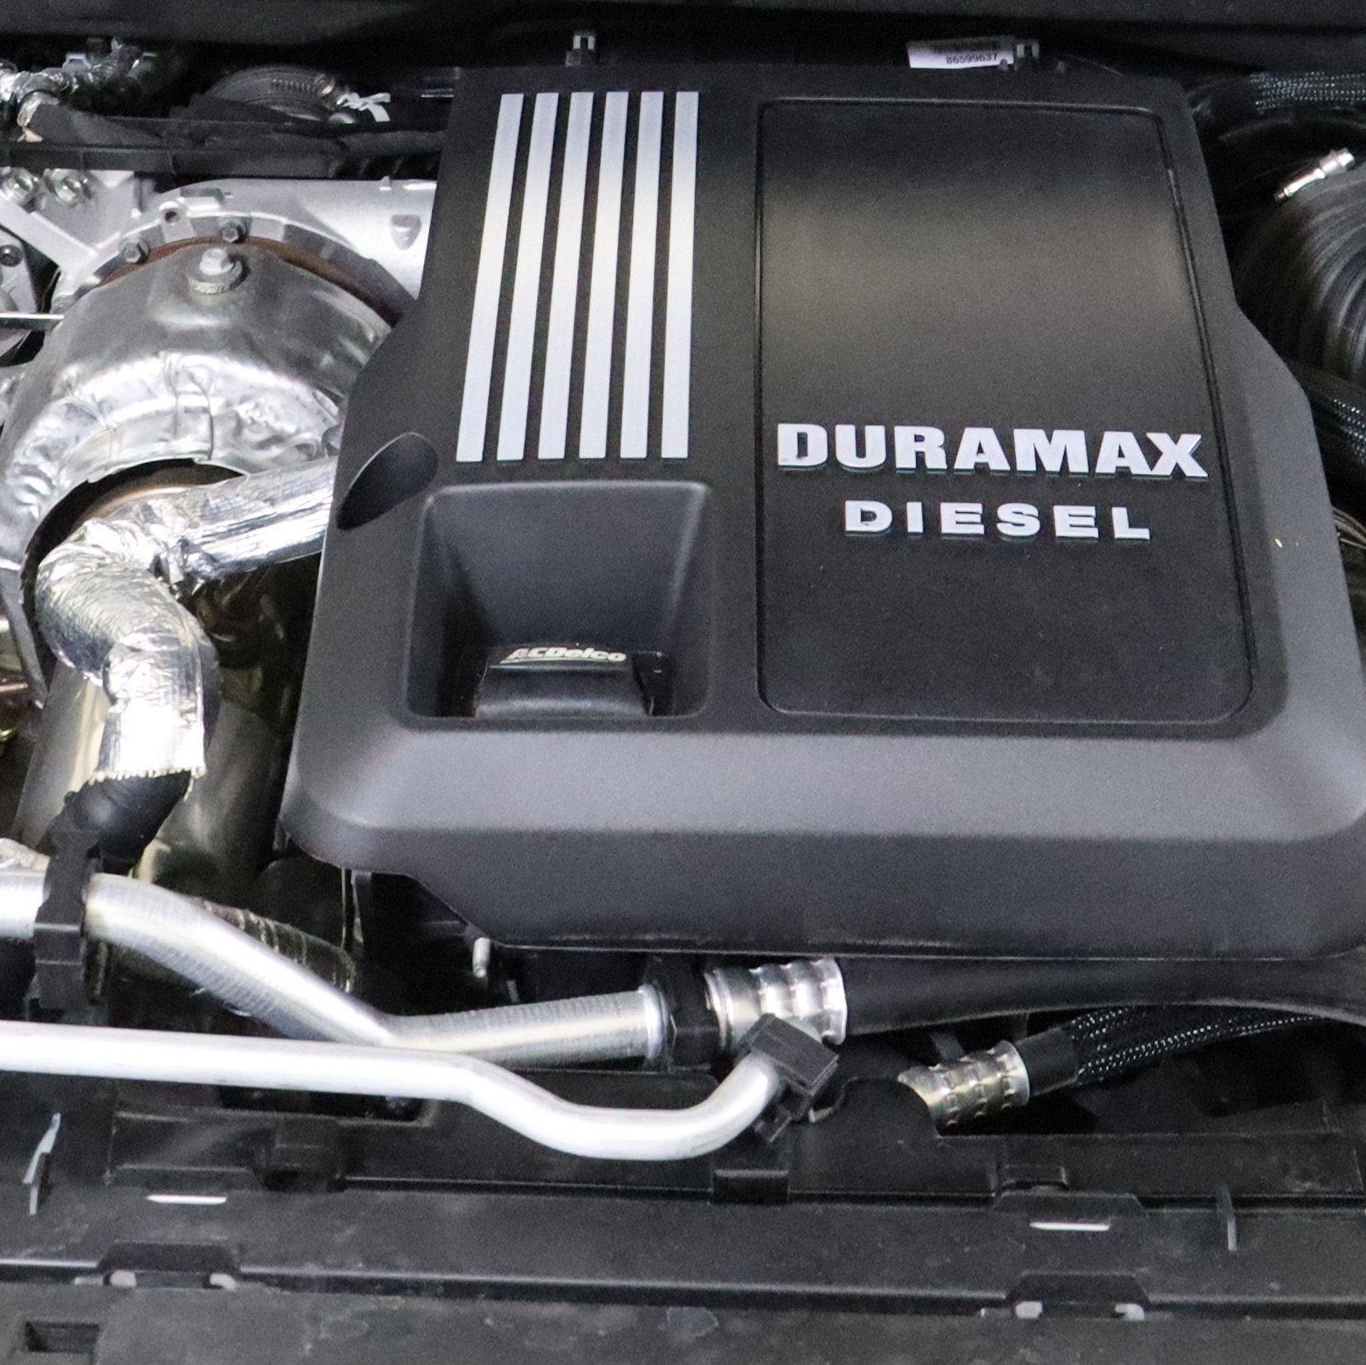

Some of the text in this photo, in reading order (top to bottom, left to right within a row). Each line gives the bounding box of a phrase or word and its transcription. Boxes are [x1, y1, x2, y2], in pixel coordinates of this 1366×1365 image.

[777, 422, 1209, 480] DURAMAX
[844, 499, 1151, 540] DIESEL
[500, 646, 627, 664] ACDelco
